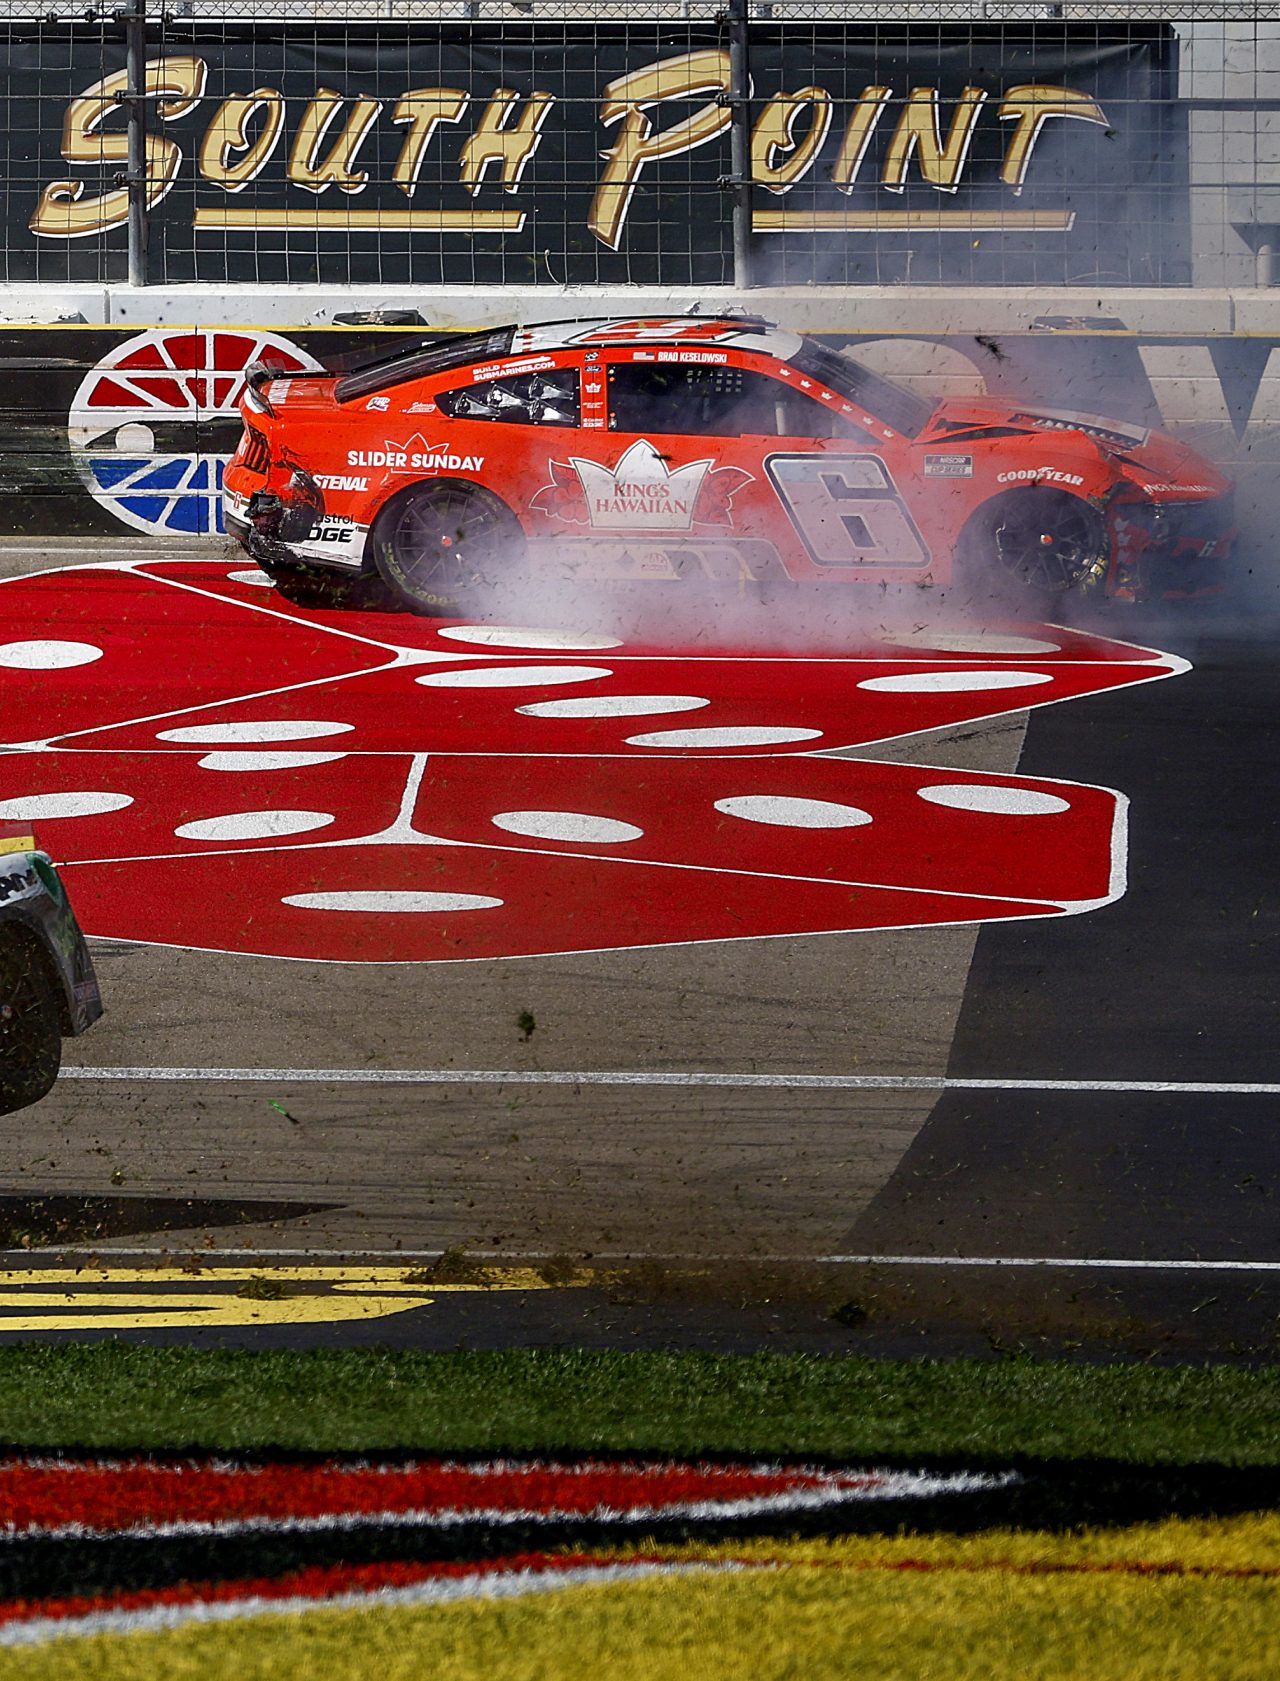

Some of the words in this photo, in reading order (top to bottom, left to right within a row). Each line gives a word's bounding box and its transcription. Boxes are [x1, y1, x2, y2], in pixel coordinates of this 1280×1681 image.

[29, 56, 557, 238] SOUTH
[588, 48, 1108, 250] POINT
[658, 351, 678, 362] BRAD
[680, 352, 727, 363] KESELOWSKI
[473, 364, 500, 376] BUILD
[473, 361, 556, 381] SUBMARINES.COM
[347, 450, 408, 468] SLIDER
[410, 452, 485, 472] SUNDAY
[312, 474, 369, 491] STENAL
[613, 482, 671, 497] KING'S
[231, 490, 242, 510] 6
[596, 499, 688, 514] HAWAIIAN
[763, 451, 933, 569] 6
[316, 513, 355, 525] astrol
[305, 527, 355, 543] DGE
